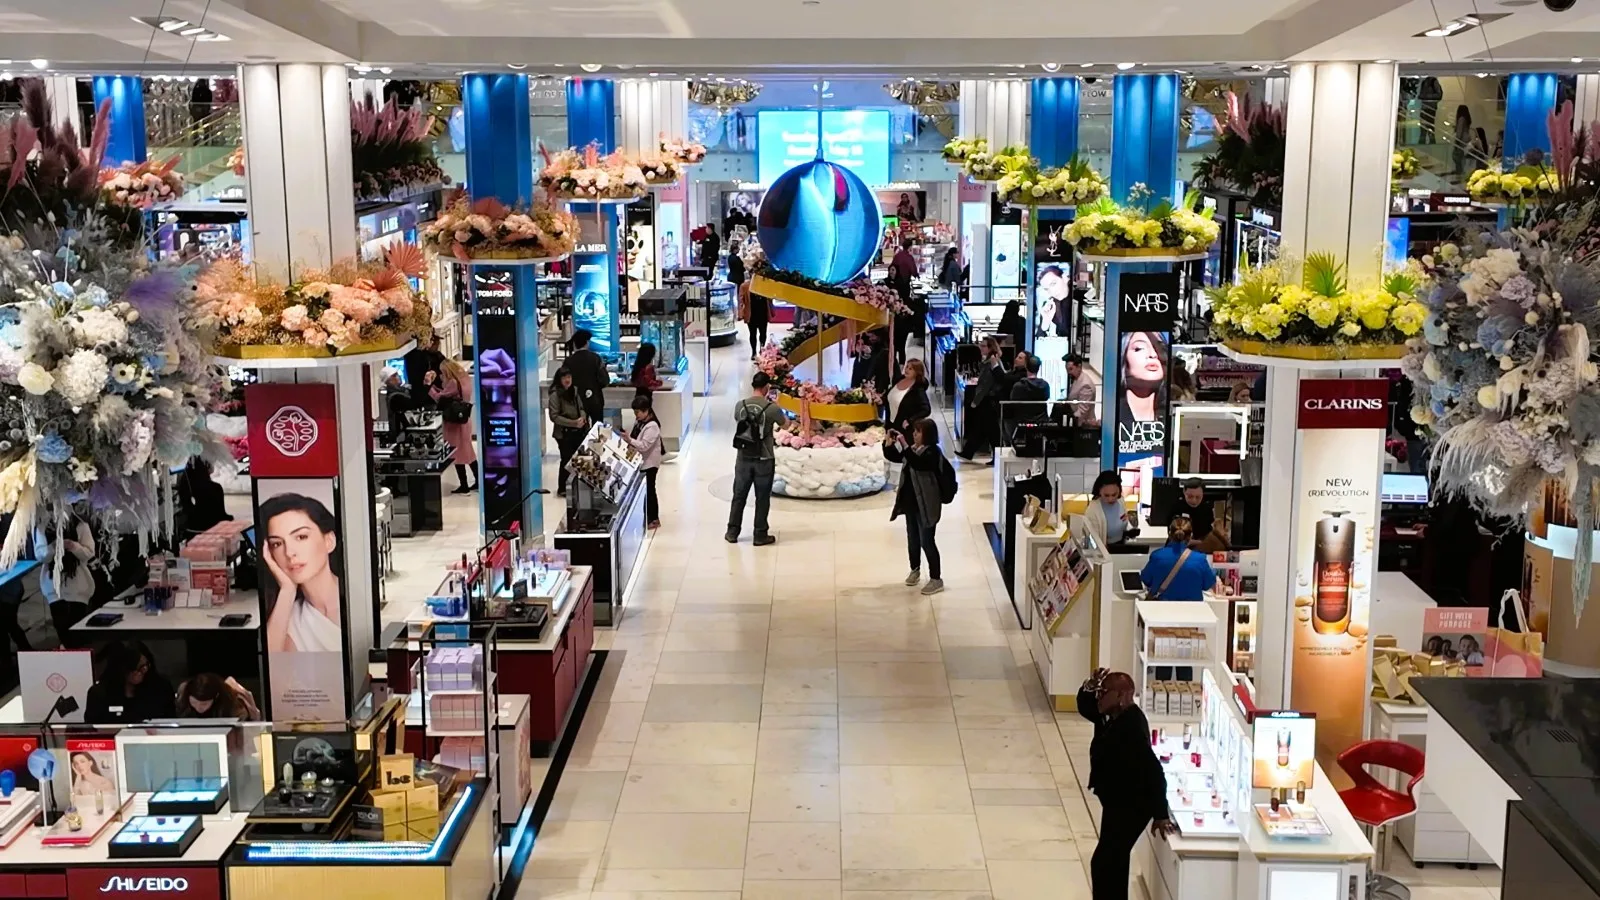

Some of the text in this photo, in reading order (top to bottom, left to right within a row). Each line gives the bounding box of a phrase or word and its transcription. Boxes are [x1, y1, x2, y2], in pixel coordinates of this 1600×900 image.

[574, 243, 607, 253] LA MER
[477, 290, 513, 298] TOM FORD
[1124, 293, 1169, 313] NARS
[1304, 398, 1383, 410] CLARINS
[1119, 421, 1165, 441] NARS
[1325, 478, 1353, 487] NEW
[1308, 489, 1369, 498] (R)EVOLUTION
[1439, 611, 1473, 620] GIFT WITH
[1439, 620, 1472, 629] PURPOSE
[100, 876, 188, 892] SHISEIDO
